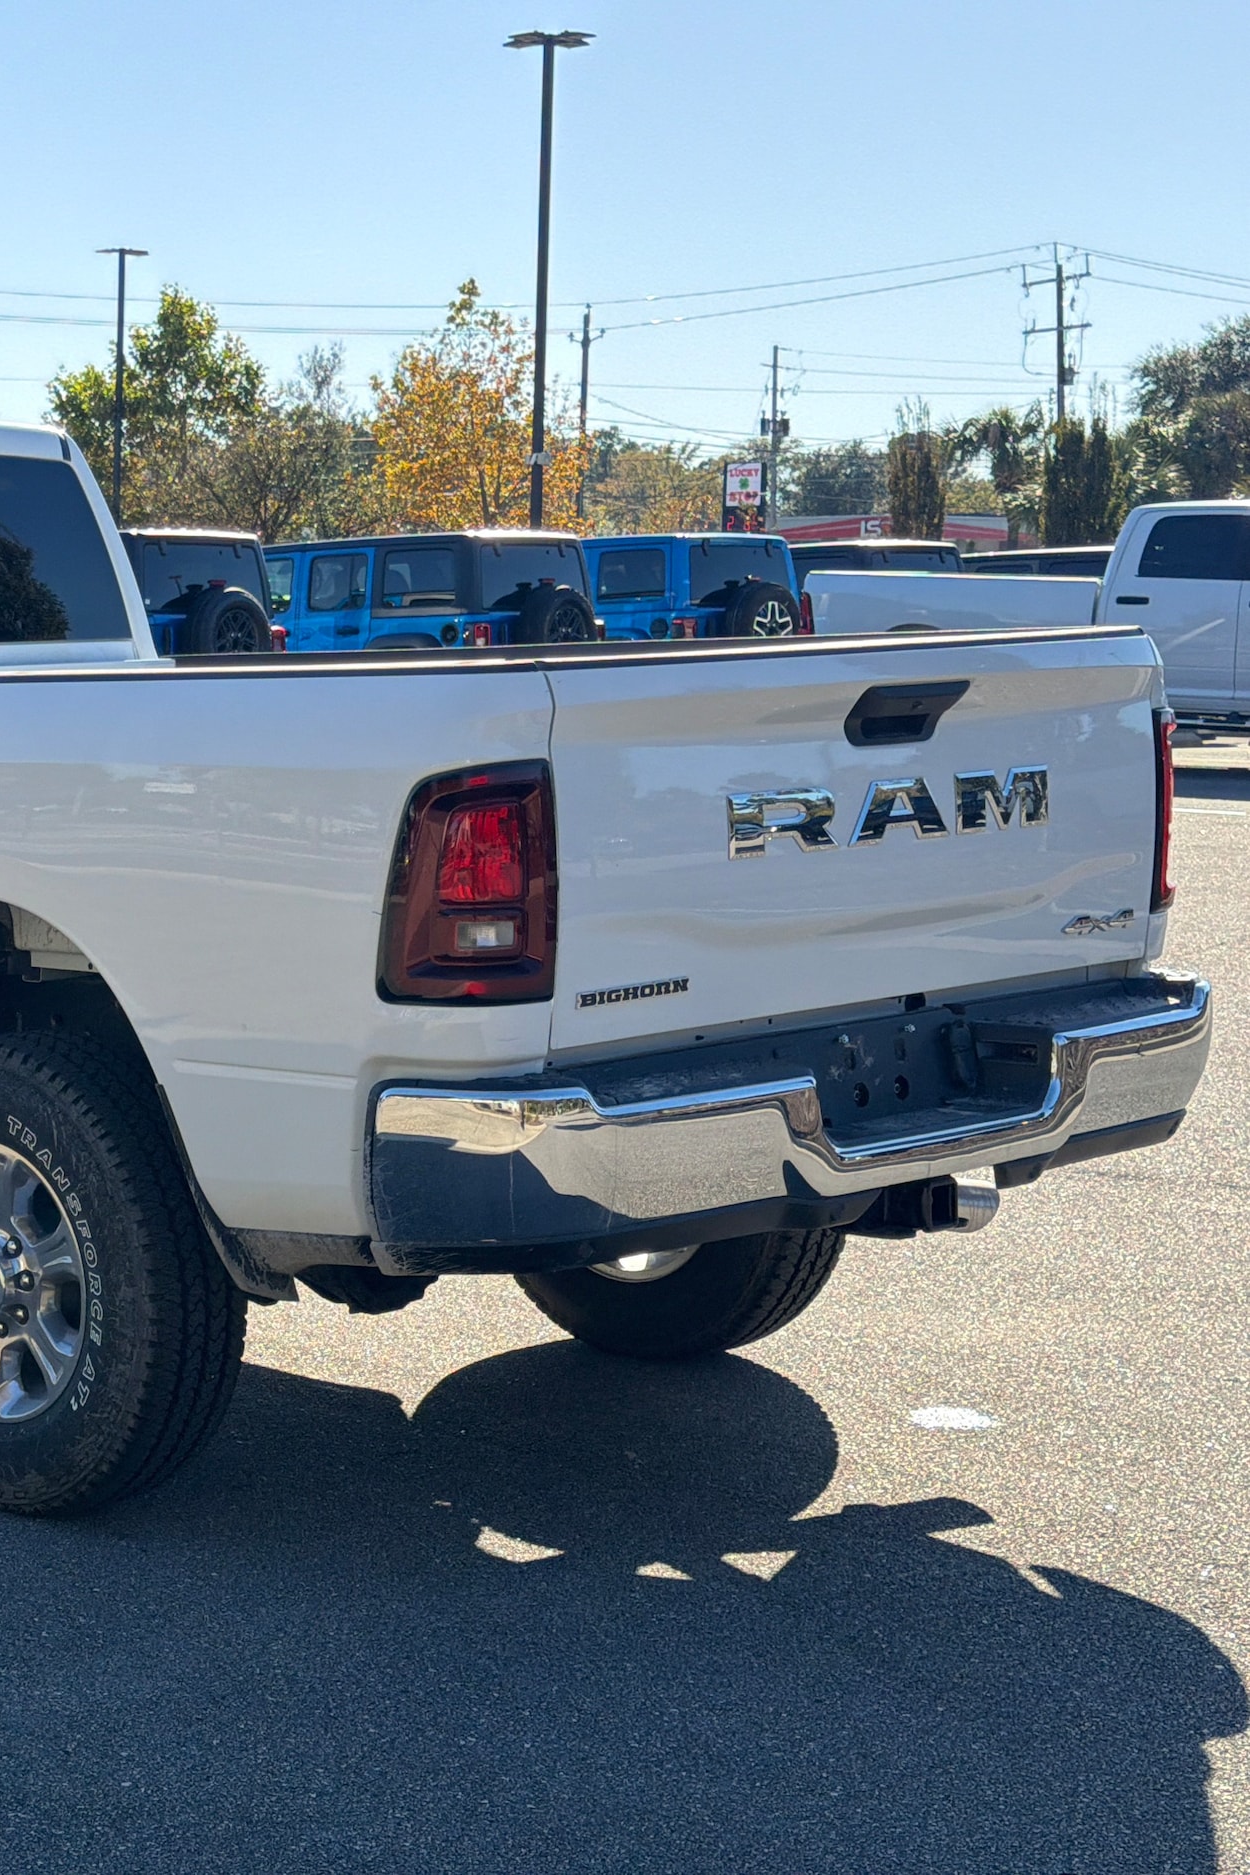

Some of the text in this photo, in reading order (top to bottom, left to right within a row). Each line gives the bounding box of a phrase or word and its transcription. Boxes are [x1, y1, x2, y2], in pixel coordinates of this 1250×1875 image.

[729, 468, 760, 477] LUCKY
[726, 763, 1049, 861] RAM
[575, 976, 690, 1010] BIGHORN
[7, 1115, 103, 1347] TRANSFORCE
